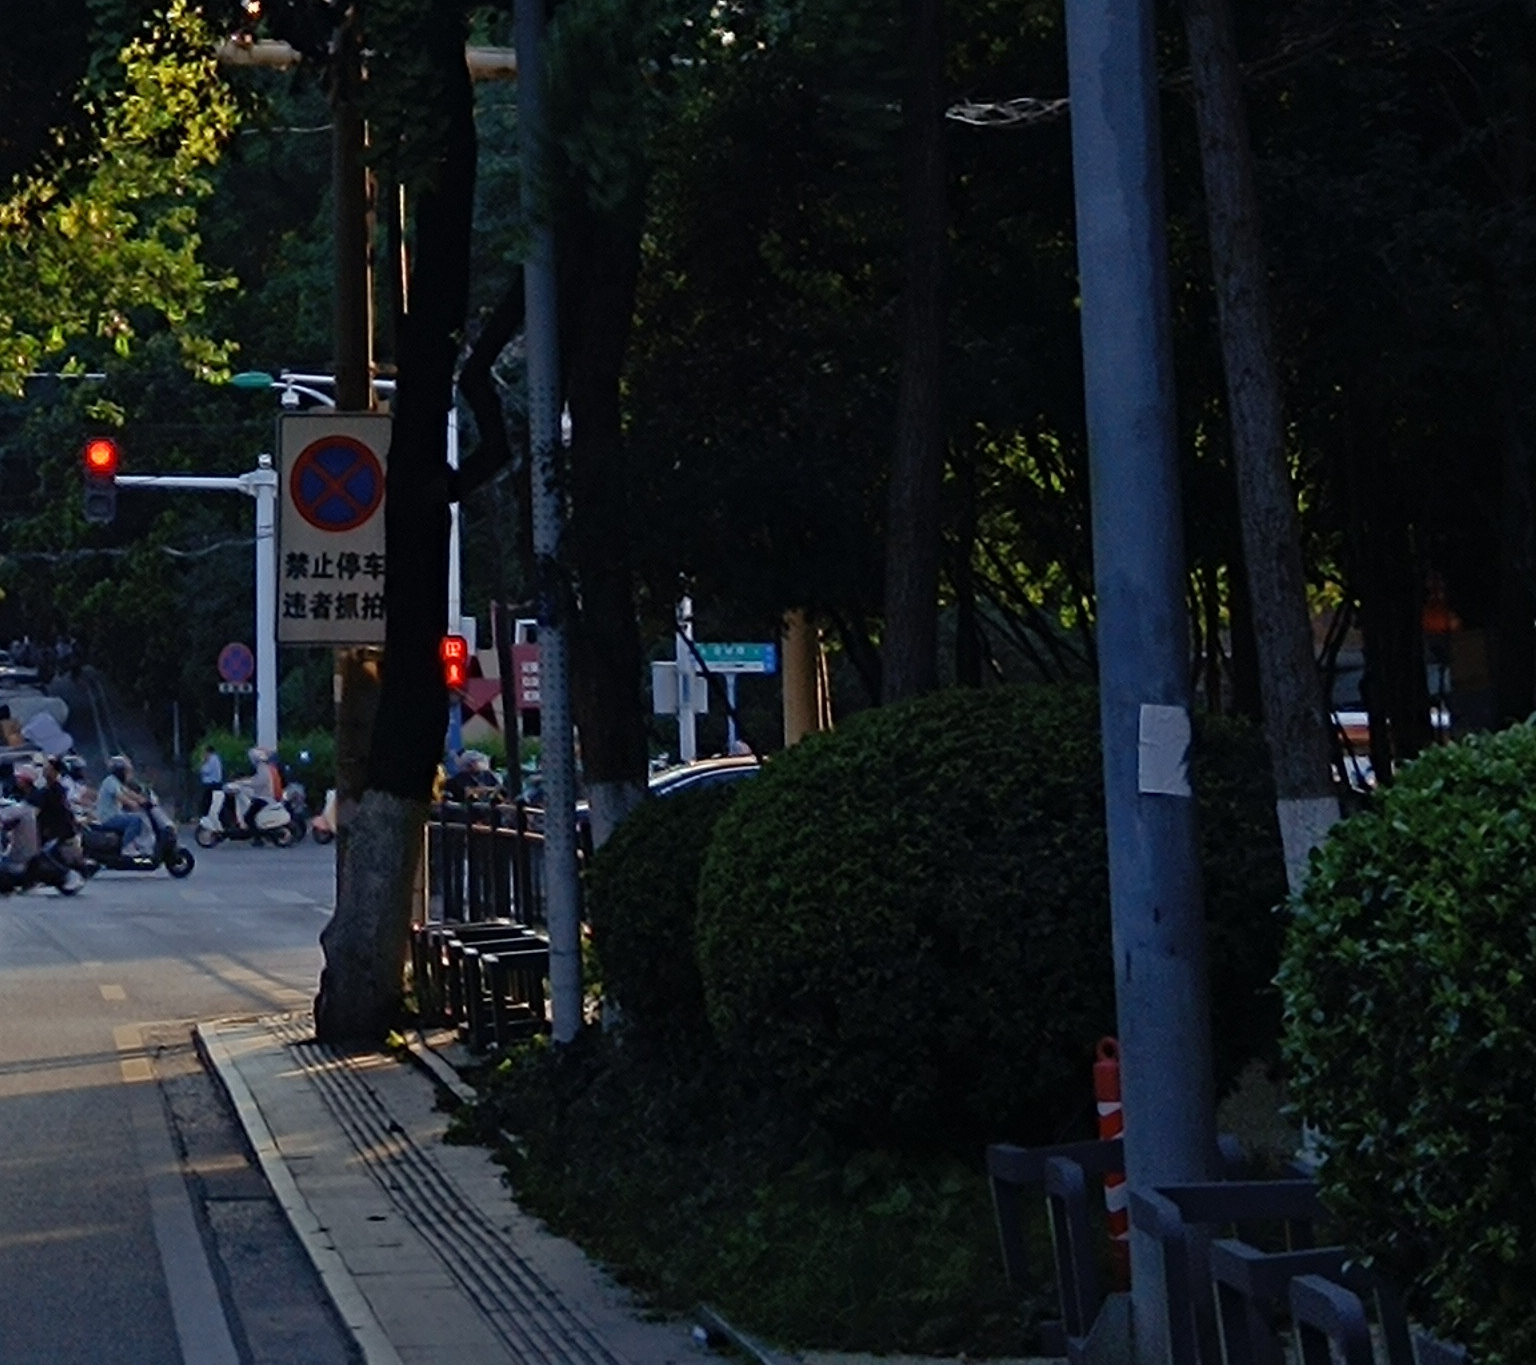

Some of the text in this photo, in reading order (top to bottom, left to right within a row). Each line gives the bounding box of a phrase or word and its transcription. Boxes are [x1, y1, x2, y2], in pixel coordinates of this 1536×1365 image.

[284, 551, 385, 581] 禁止停车
[282, 591, 385, 620] 违者抓拍
